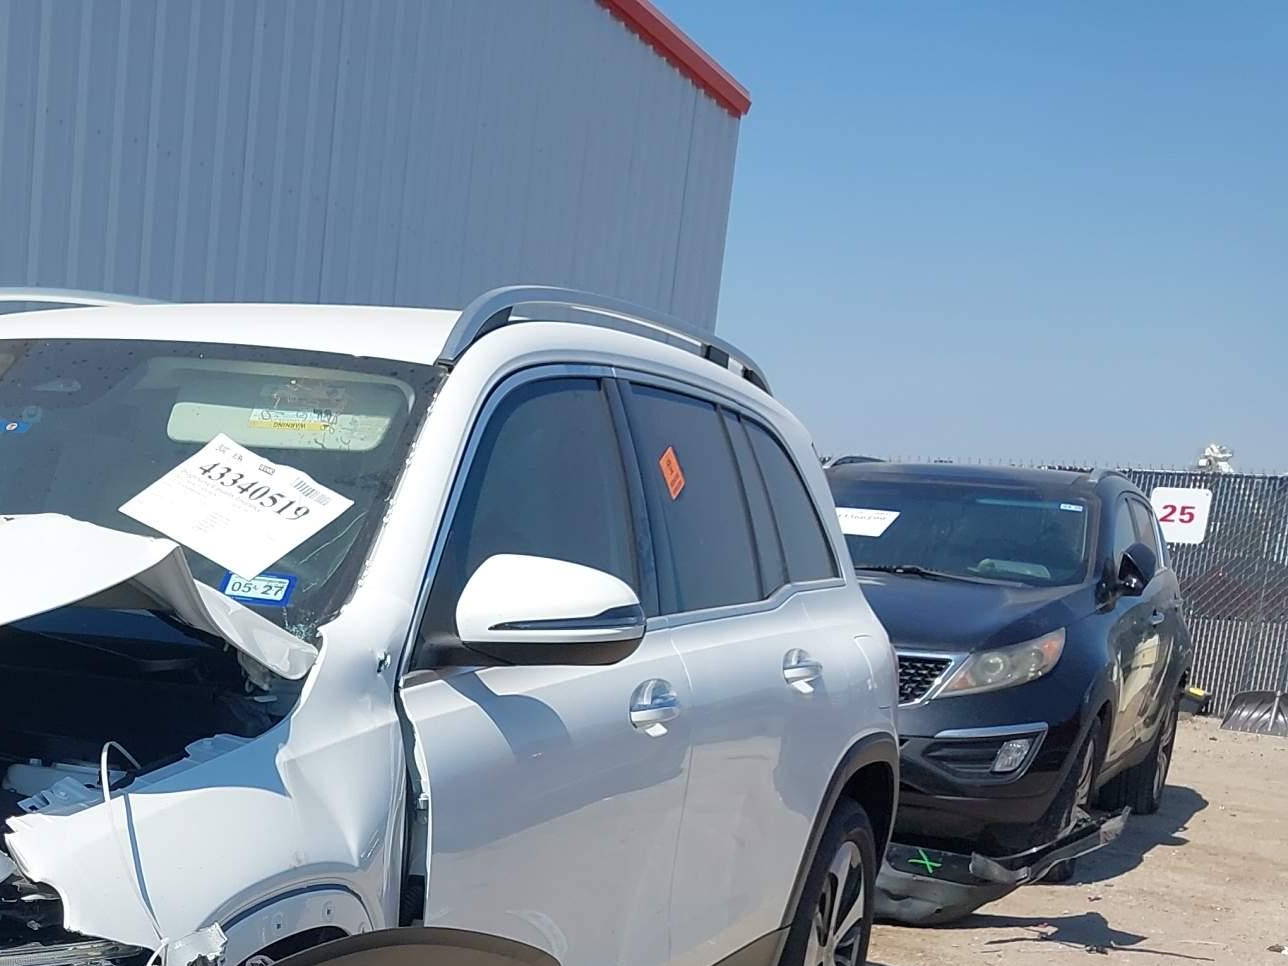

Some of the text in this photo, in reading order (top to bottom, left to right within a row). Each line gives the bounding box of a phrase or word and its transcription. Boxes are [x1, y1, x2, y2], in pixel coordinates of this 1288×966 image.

[200, 462, 311, 521] 43340519
[1159, 504, 1196, 523] 25
[231, 581, 284, 596] 05 27
